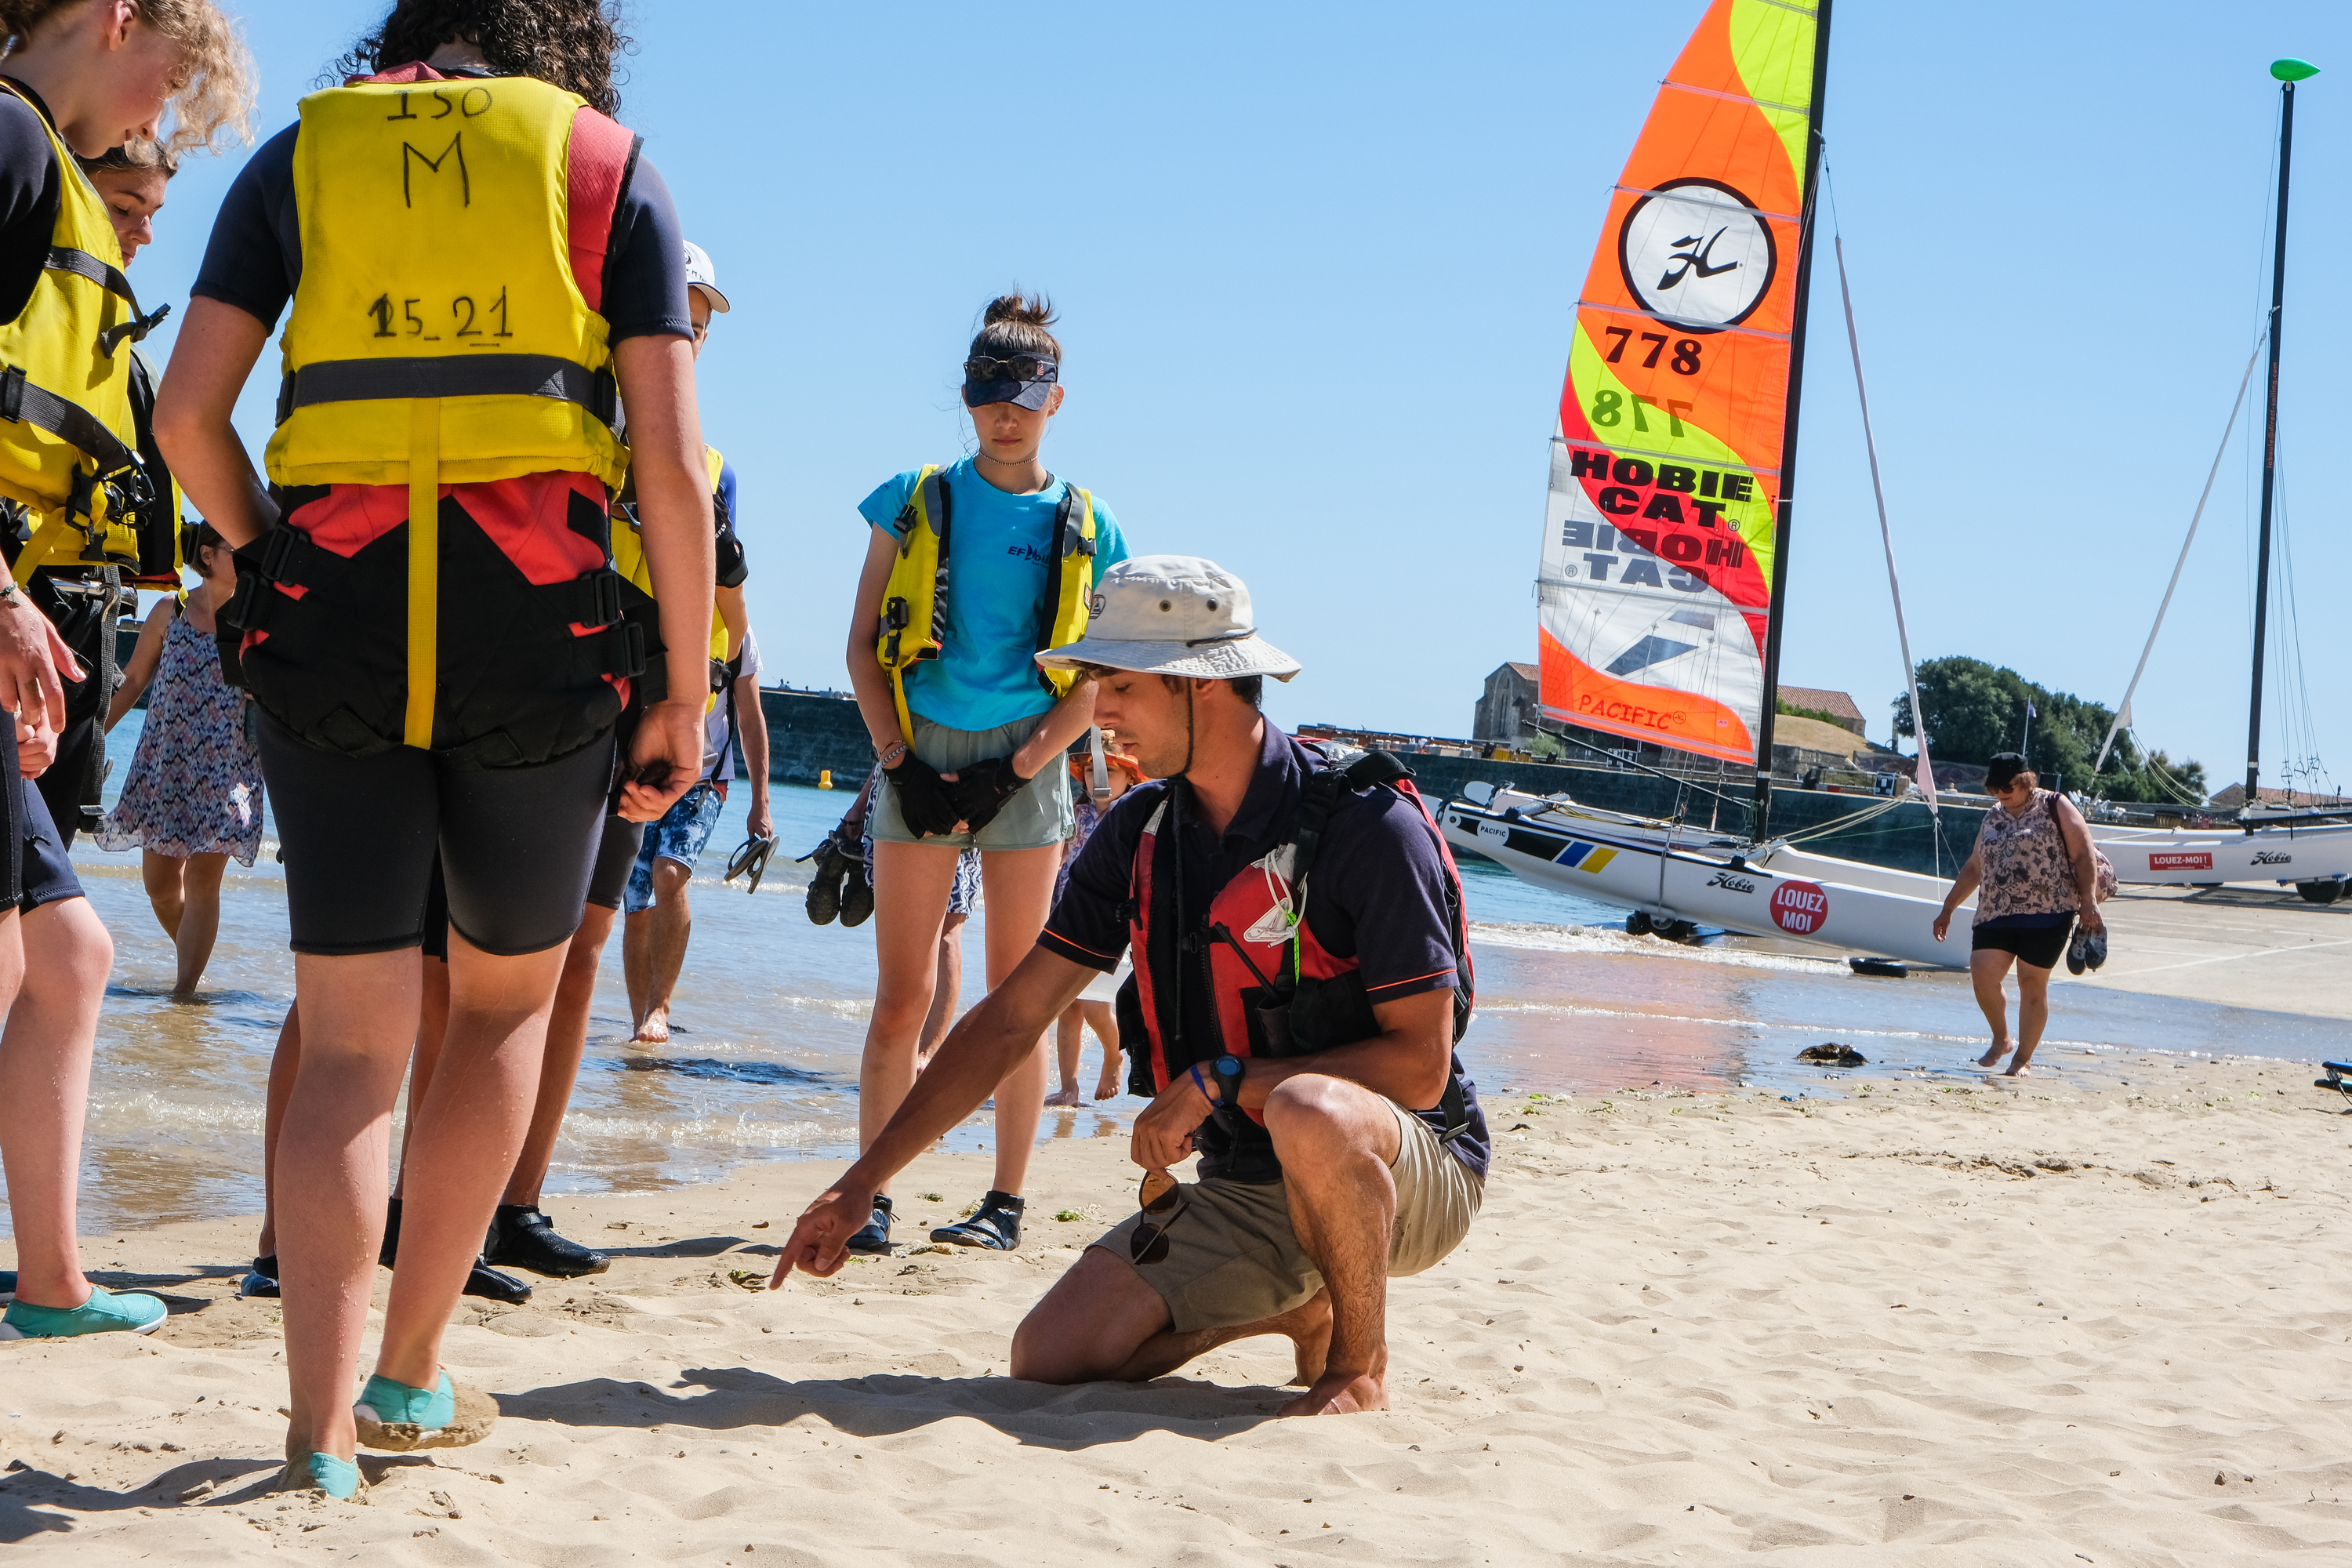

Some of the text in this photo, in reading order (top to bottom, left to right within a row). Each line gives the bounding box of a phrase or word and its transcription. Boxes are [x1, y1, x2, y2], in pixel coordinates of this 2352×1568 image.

[387, 87, 492, 121] ISO
[403, 130, 470, 209] M
[1605, 325, 1702, 376] 778
[1570, 450, 1754, 503] HOBIE
[1578, 694, 1672, 730] PACIFIC
[1480, 826, 1507, 837] PACIFIC
[2250, 851, 2292, 866] Hobie
[1706, 872, 1755, 894] Hobie
[1777, 887, 1825, 913] LOUEZ
[1781, 910, 1813, 932] MOI
